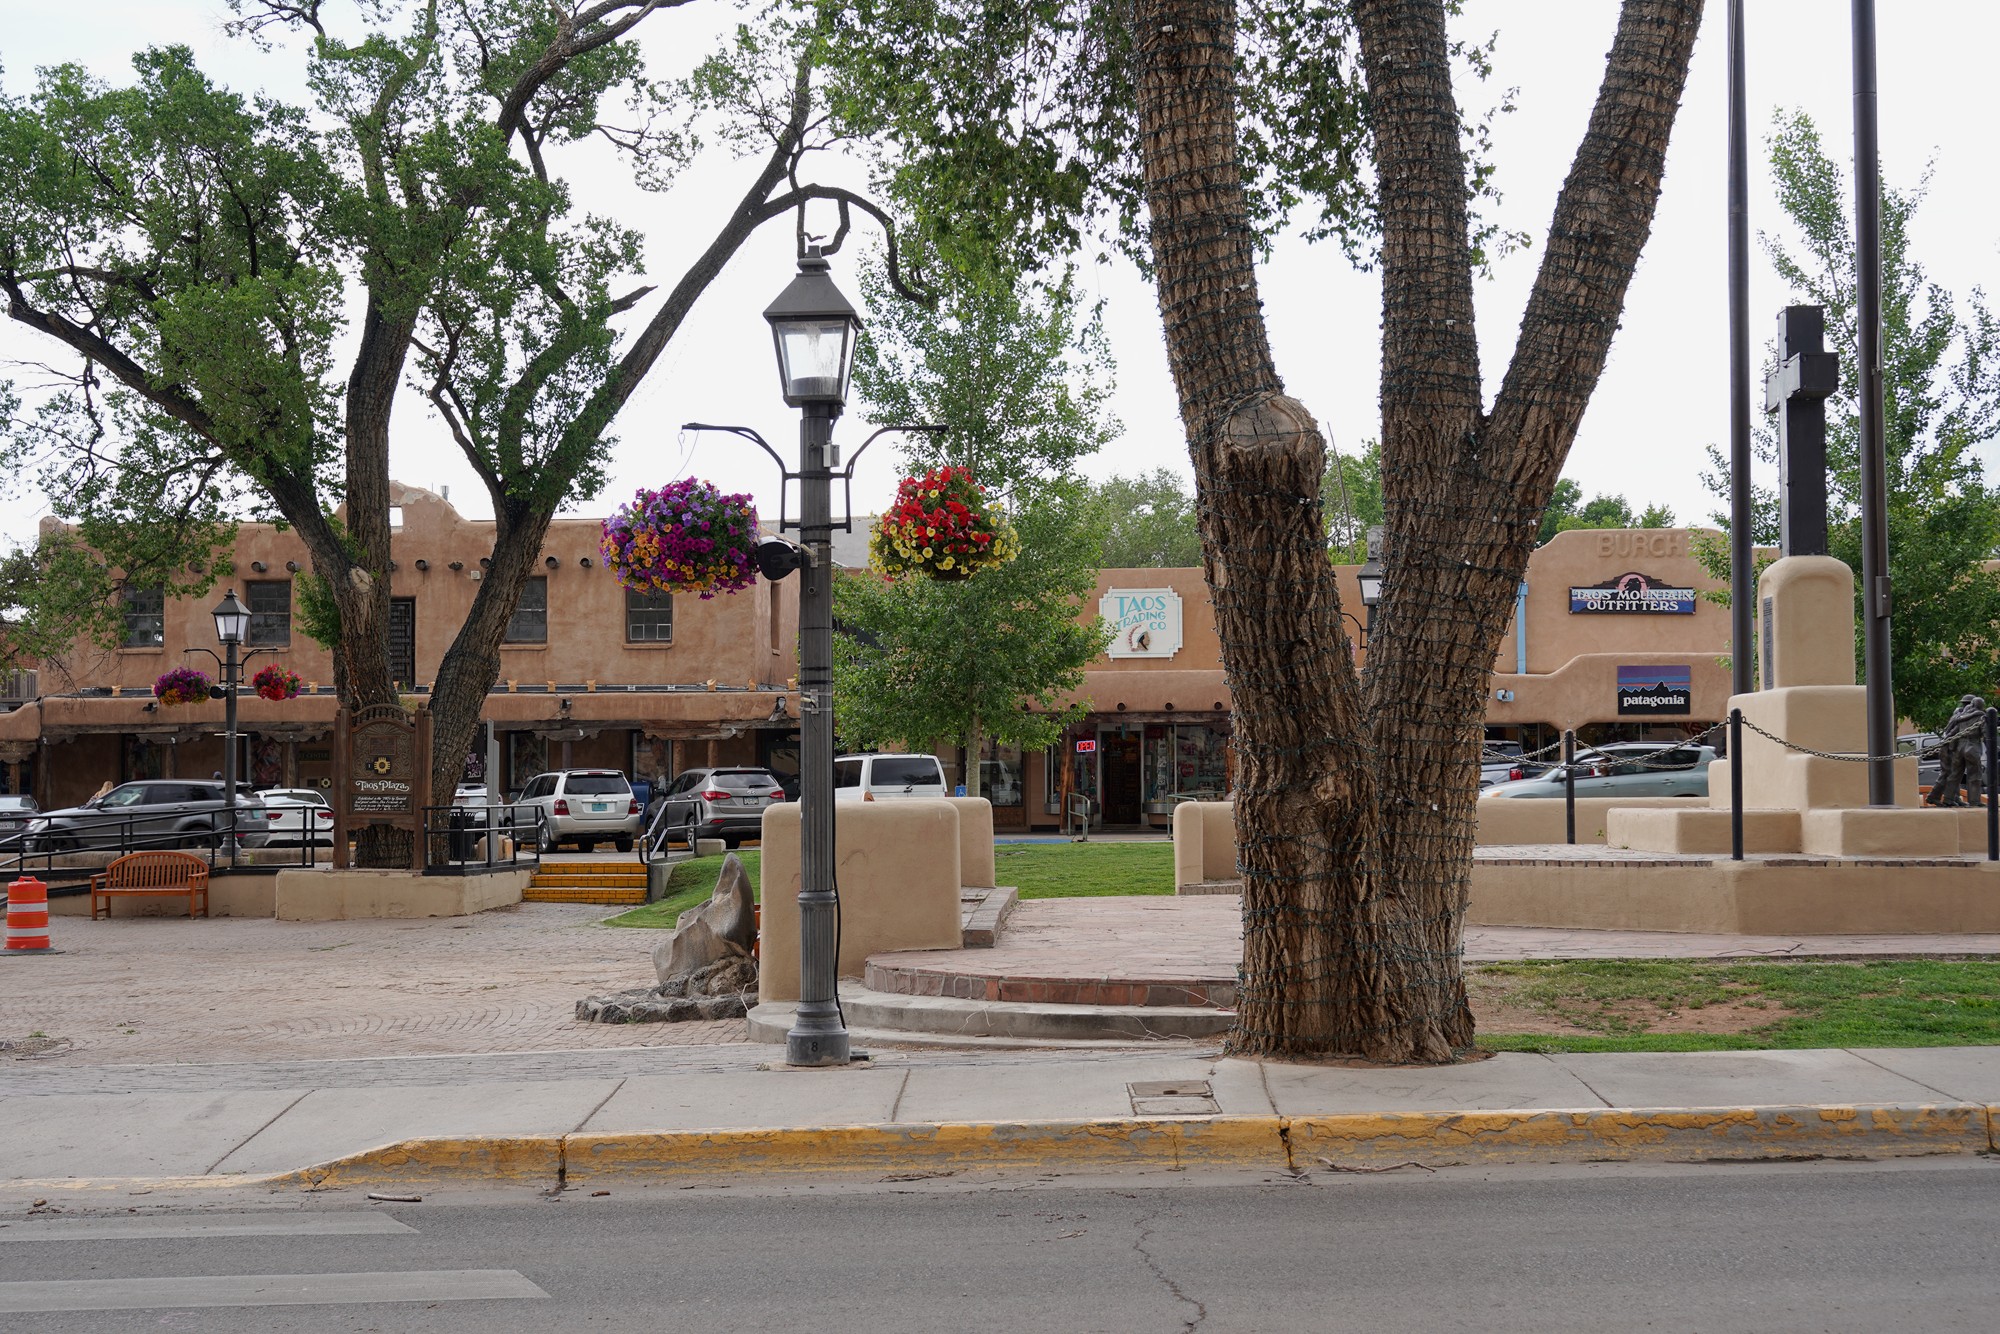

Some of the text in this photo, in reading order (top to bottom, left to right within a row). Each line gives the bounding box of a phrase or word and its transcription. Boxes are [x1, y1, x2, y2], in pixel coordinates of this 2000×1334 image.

[1598, 533, 1682, 558] BURCH
[1576, 589, 1696, 601] TAOS MOUNTAIN
[1114, 596, 1166, 618] TAOS
[1586, 600, 1679, 611] OUTFITTERS
[1116, 611, 1167, 631] TRADING
[1149, 621, 1167, 631] CO
[1623, 694, 1685, 707] patagonia
[1077, 741, 1095, 751] OPEN
[355, 780, 410, 792] Taos Plaza
[811, 1041, 819, 1052] 8
